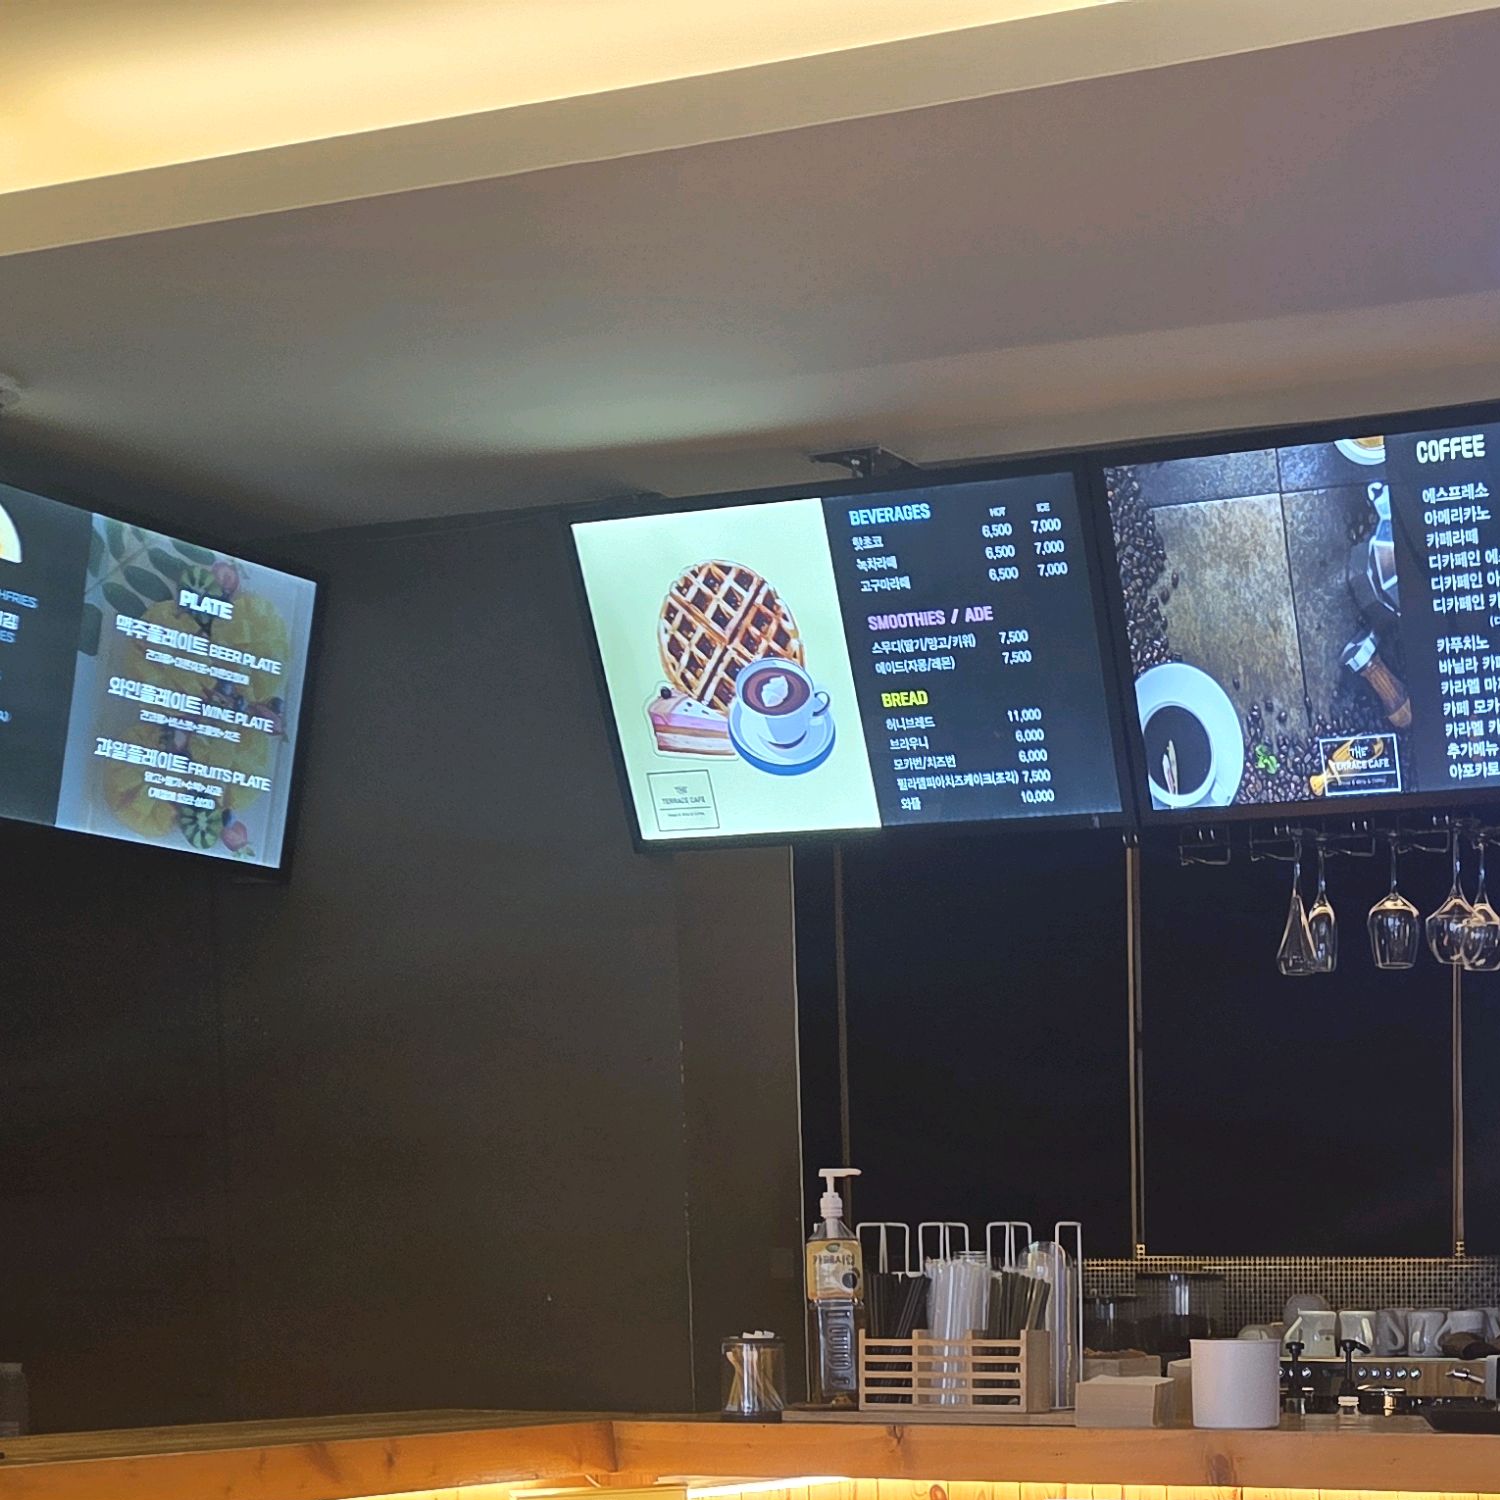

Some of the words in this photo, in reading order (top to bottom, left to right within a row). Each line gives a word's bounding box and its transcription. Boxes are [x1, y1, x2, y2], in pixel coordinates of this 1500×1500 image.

[1416, 434, 1486, 464] COFFEE
[1422, 482, 1490, 504] 에스프레소
[849, 503, 931, 527] BEVERAGES
[1424, 505, 1491, 527] 아메리카노
[982, 523, 1012, 539] 6,500
[1031, 518, 1061, 534] 7,000
[1426, 528, 1479, 548] 카페라떼
[985, 545, 1016, 560] 6,500
[1034, 540, 1065, 556] 7,000
[1429, 549, 1480, 571] 디카페인
[988, 566, 1019, 582] 6,500
[1037, 562, 1068, 578] 7,000
[1431, 572, 1482, 593] 디카페인
[179, 589, 233, 621] PLATE
[1433, 594, 1485, 614] 디카페인
[868, 610, 945, 631] SMOOTHIES
[950, 609, 959, 625] /
[965, 606, 994, 623] ADE
[999, 630, 1029, 645] 7,500
[1436, 634, 1489, 654] 카푸치노
[210, 643, 242, 663] BEER
[243, 653, 282, 675] PLATE
[1002, 650, 1032, 665] 7,500
[1438, 656, 1478, 676] 바닐라
[1441, 678, 1480, 697] 카라멜
[881, 690, 928, 708] BREAD
[1443, 701, 1469, 717] 카페
[1474, 698, 1500, 713] 모카
[202, 703, 234, 723] WINE
[234, 711, 274, 733] PLATE
[886, 716, 935, 731] 허니브레드
[1008, 708, 1042, 723] 11,000
[890, 736, 929, 750] 브라우니
[1016, 729, 1044, 743] 6,000
[1445, 720, 1484, 740] 카라멜
[1447, 740, 1499, 760] 추가메뉴
[189, 762, 232, 783] FRUITS
[232, 771, 271, 792] PLATE
[1022, 770, 1051, 784] 7,500
[1021, 790, 1055, 804] 10,000
